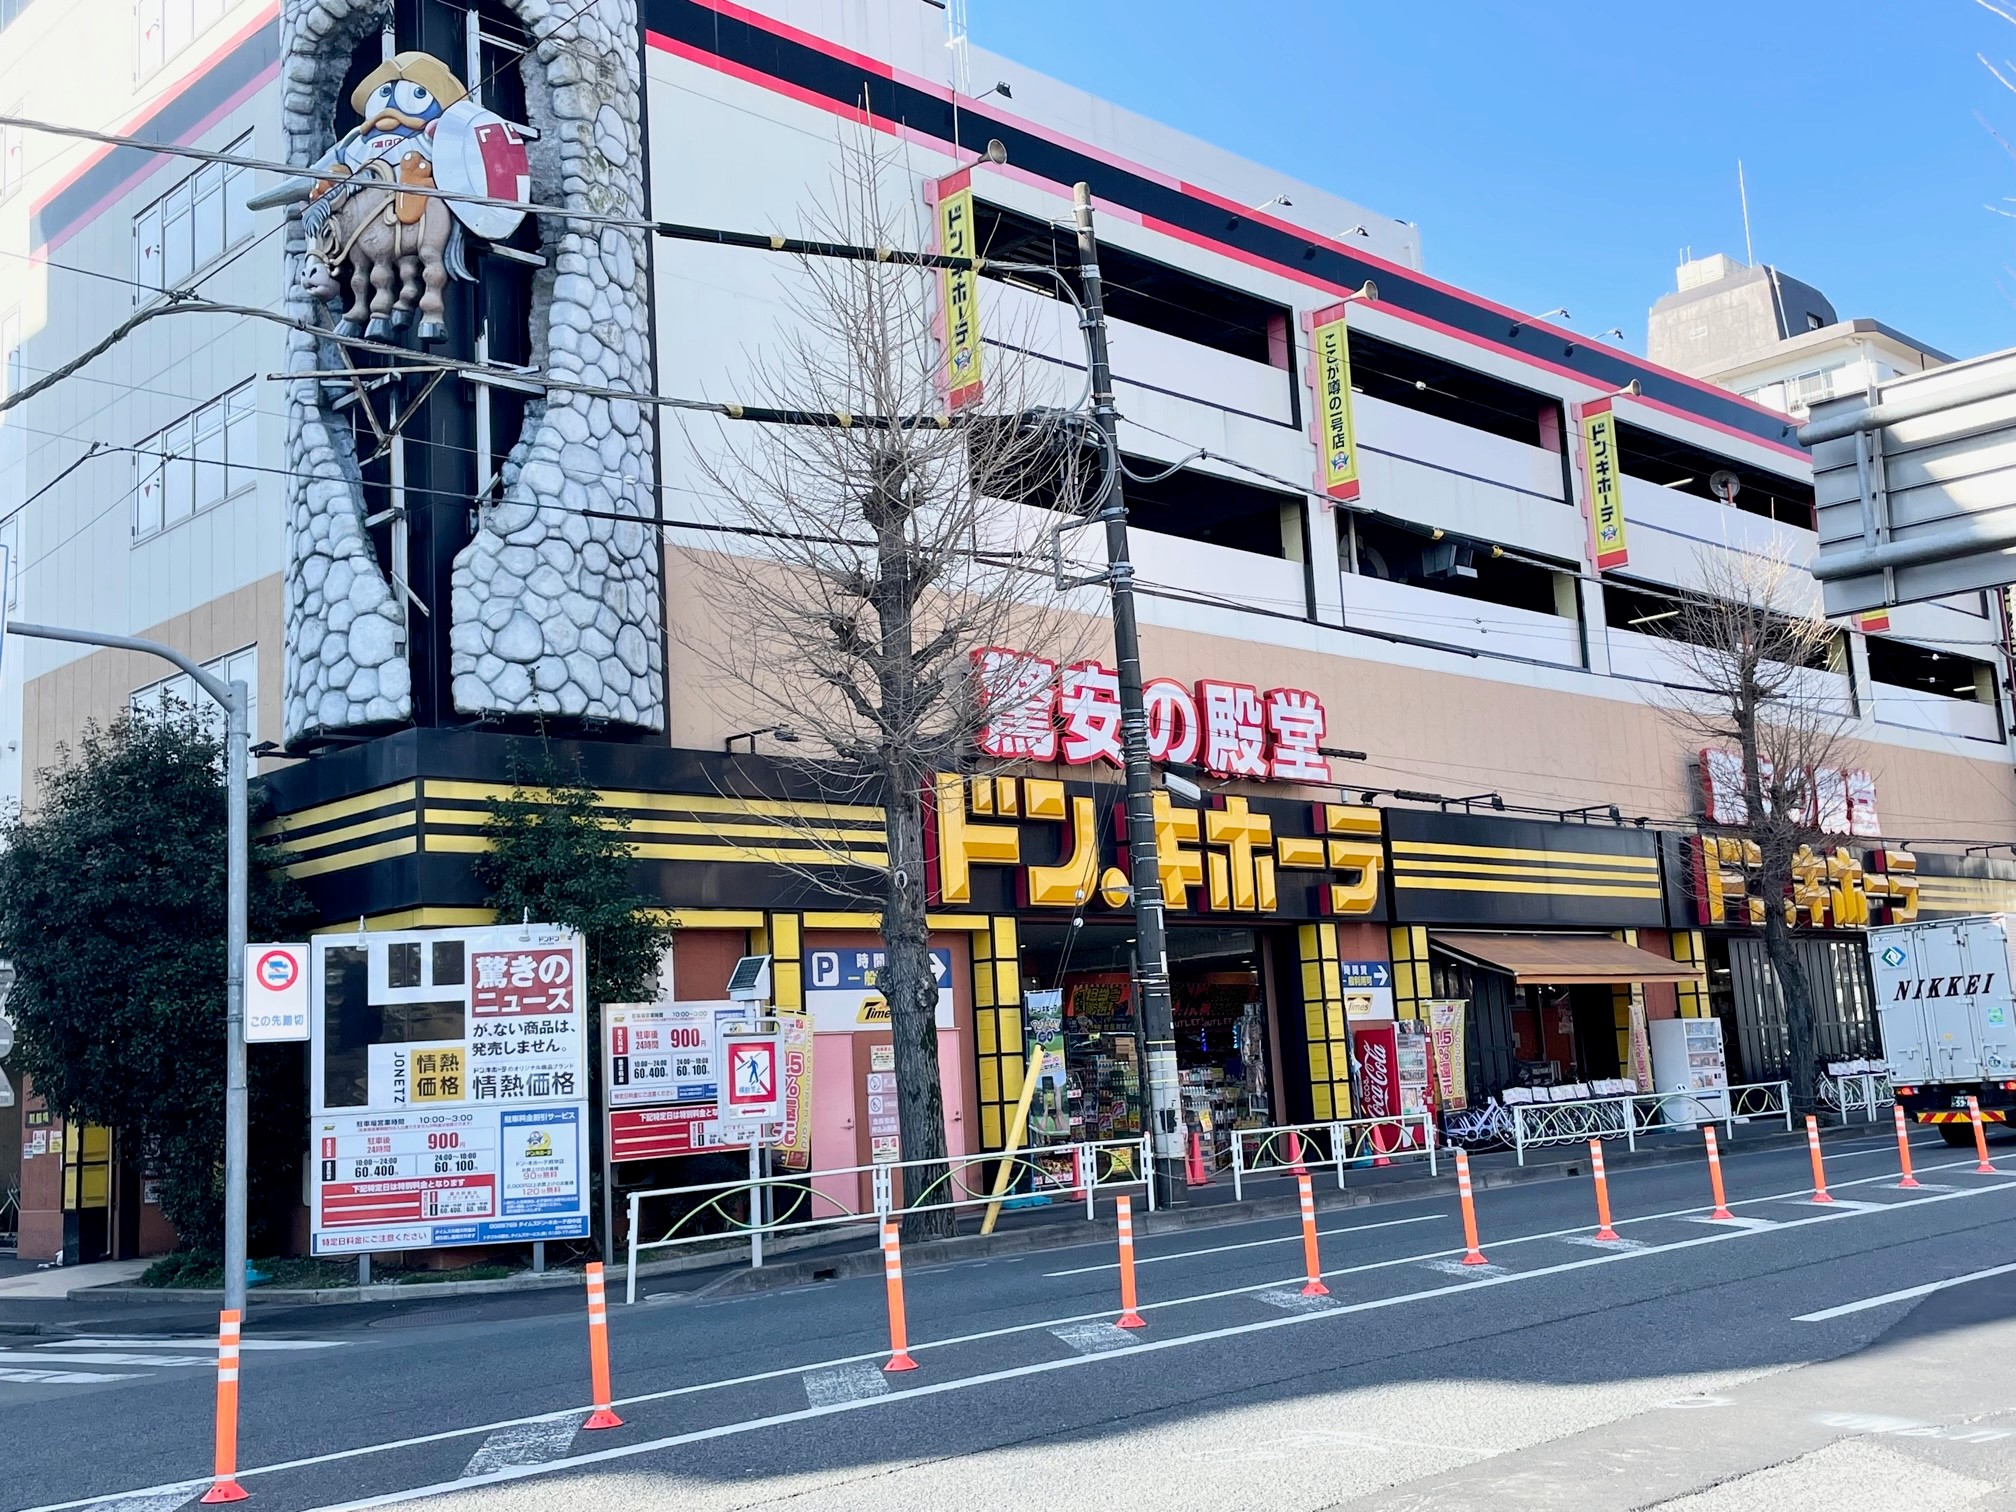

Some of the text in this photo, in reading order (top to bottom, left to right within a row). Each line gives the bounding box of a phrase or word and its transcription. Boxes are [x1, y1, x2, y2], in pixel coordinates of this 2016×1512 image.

[1325, 333, 1346, 450] ここが噂の一号店
[970, 646, 1331, 783] 驚安の殿堂
[475, 954, 571, 989] 驚きの
[475, 987, 570, 1013] ニュース
[1893, 973, 1995, 1002] NIKKEI
[863, 1001, 891, 1020] Time
[472, 1038, 567, 1057] 発売しません。
[393, 1051, 406, 1103] JONETZ
[416, 1052, 460, 1074] 情熱
[416, 1075, 460, 1097] 価格
[472, 1070, 576, 1100] 情熱価格
